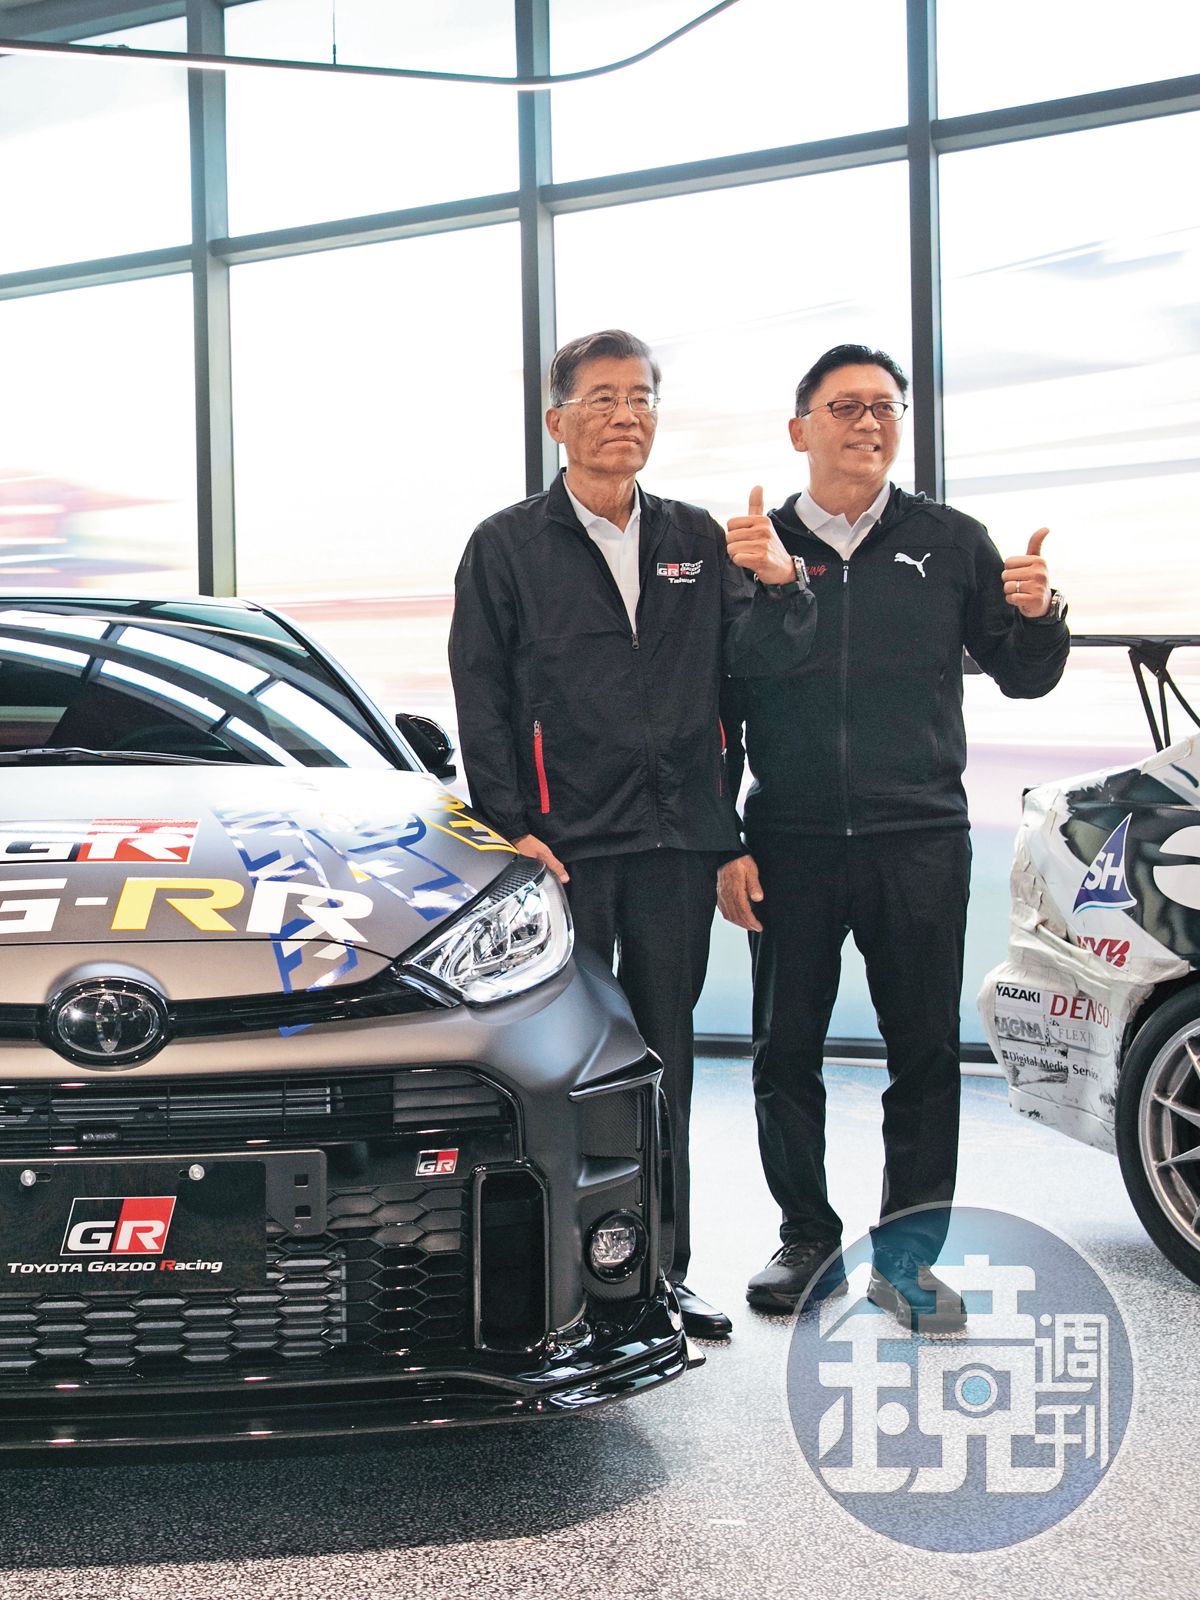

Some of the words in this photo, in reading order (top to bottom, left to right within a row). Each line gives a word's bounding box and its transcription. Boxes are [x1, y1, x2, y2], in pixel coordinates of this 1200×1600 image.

[996, 985, 1041, 1003] YAZAKI
[1050, 994, 1110, 1028] DENSO
[1008, 1051, 1038, 1068] Digital
[1040, 1059, 1069, 1074] Media
[417, 1159, 455, 1173] GR
[67, 1220, 165, 1251] GR
[7, 1262, 83, 1273] TOYOTA
[87, 1261, 156, 1272] GAZOO
[159, 1259, 223, 1273] Racing
